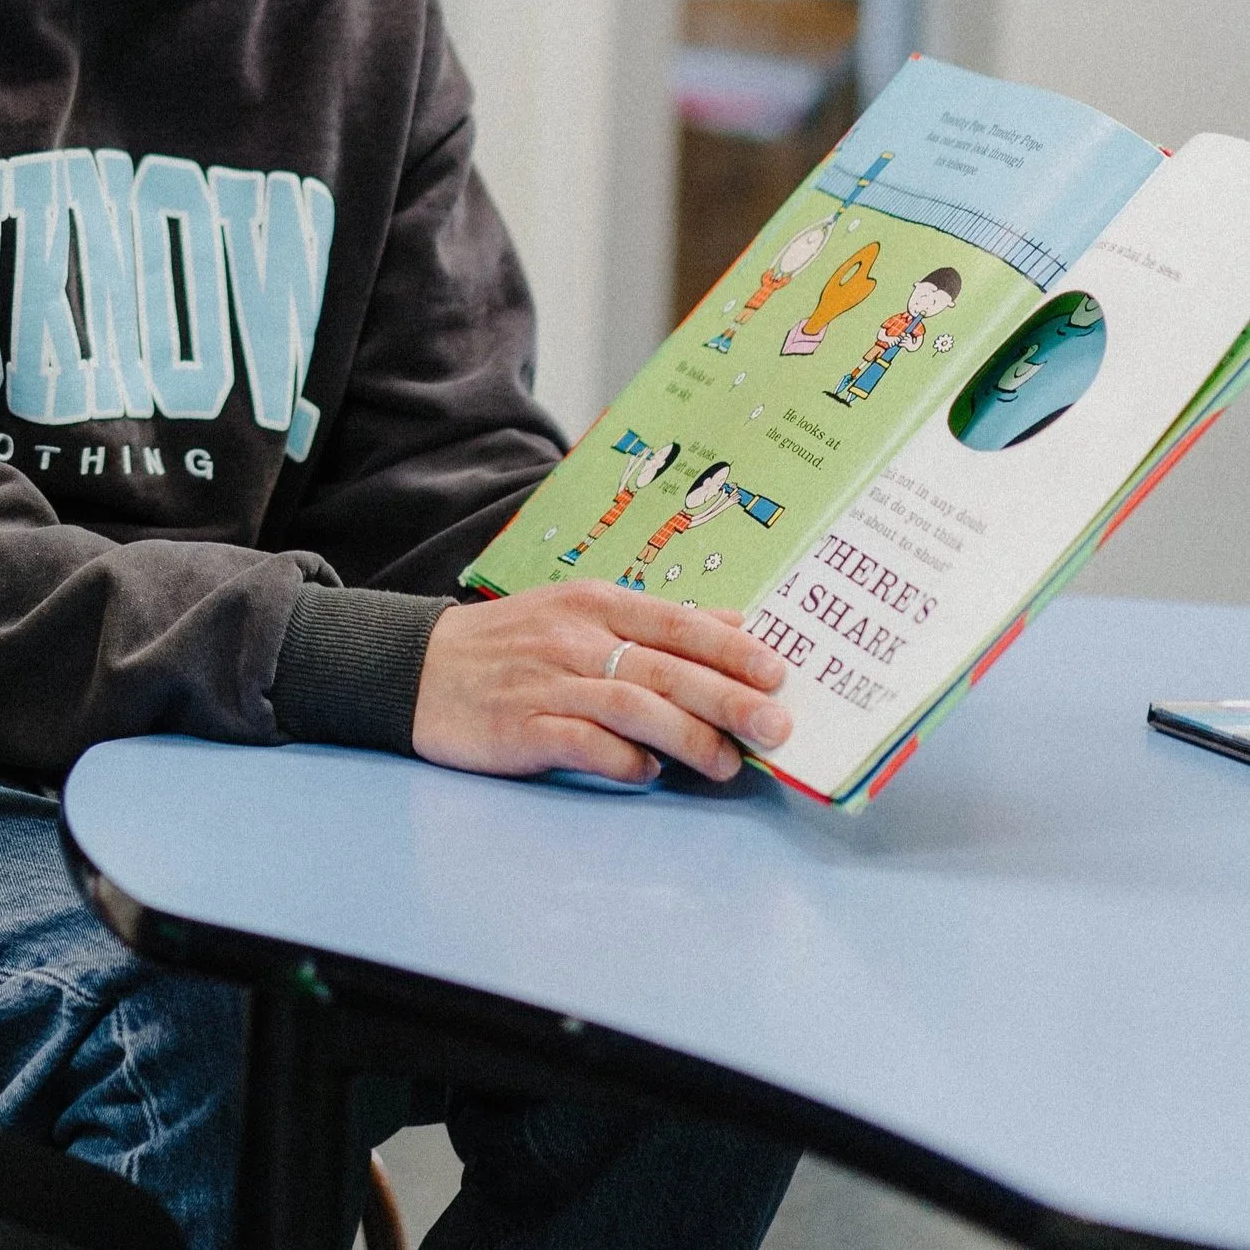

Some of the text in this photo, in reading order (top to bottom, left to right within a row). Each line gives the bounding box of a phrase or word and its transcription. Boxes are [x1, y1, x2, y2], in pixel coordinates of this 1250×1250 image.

[989, 148, 1024, 168] through
[1020, 135, 1044, 151] Pope
[766, 427, 824, 470] the ground.
[783, 408, 842, 450] He looks at
[915, 484, 930, 500] in
[931, 496, 955, 517] any
[864, 514, 897, 542] about
[899, 537, 913, 551] to
[890, 500, 906, 516] do
[905, 511, 932, 532] you
[933, 527, 963, 553] think
[747, 609, 816, 667] THE
[777, 572, 907, 665] A SHARK
